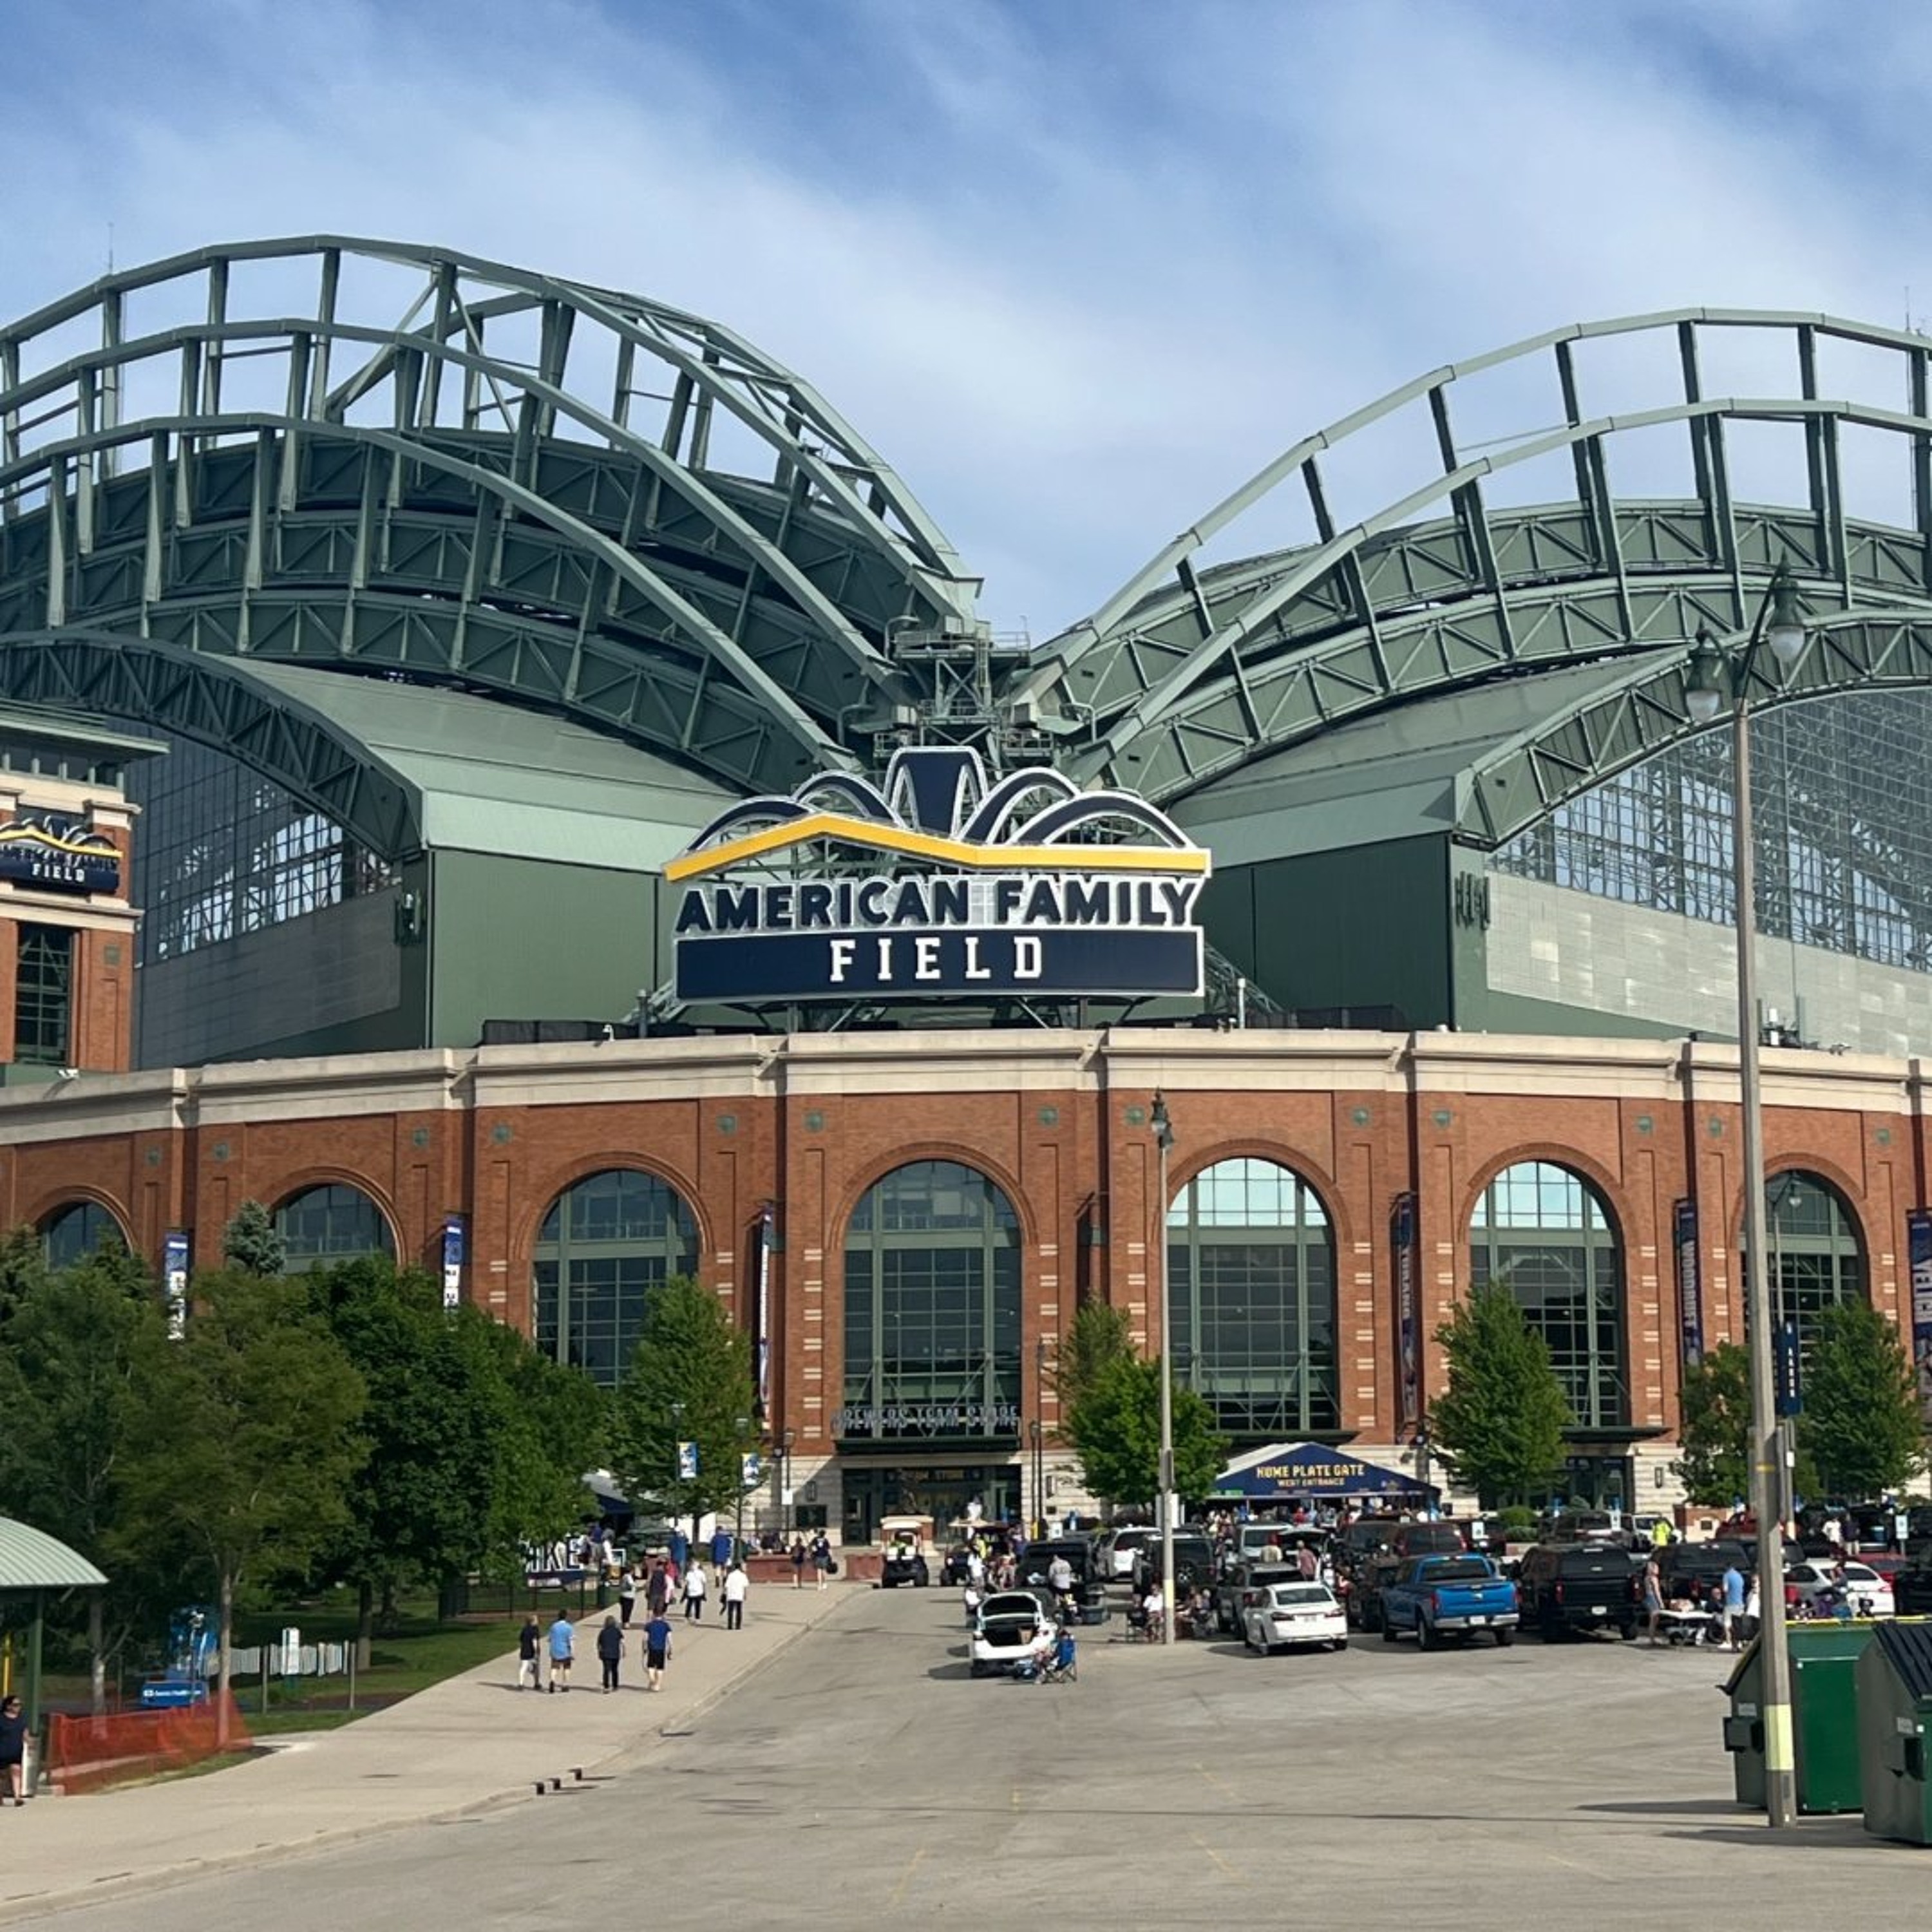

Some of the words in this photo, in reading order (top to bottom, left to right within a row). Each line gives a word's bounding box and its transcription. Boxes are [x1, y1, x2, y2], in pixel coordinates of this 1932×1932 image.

[32, 864, 85, 882] FIELD
[675, 880, 970, 933] AMERICAN
[996, 878, 1198, 925] FAMILY
[829, 936, 1043, 982] FIELD
[967, 1405, 1017, 1426] STORE
[1257, 1466, 1289, 1478] HOME
[1293, 1464, 1332, 1477] PLATE
[1334, 1464, 1365, 1476] GATE
